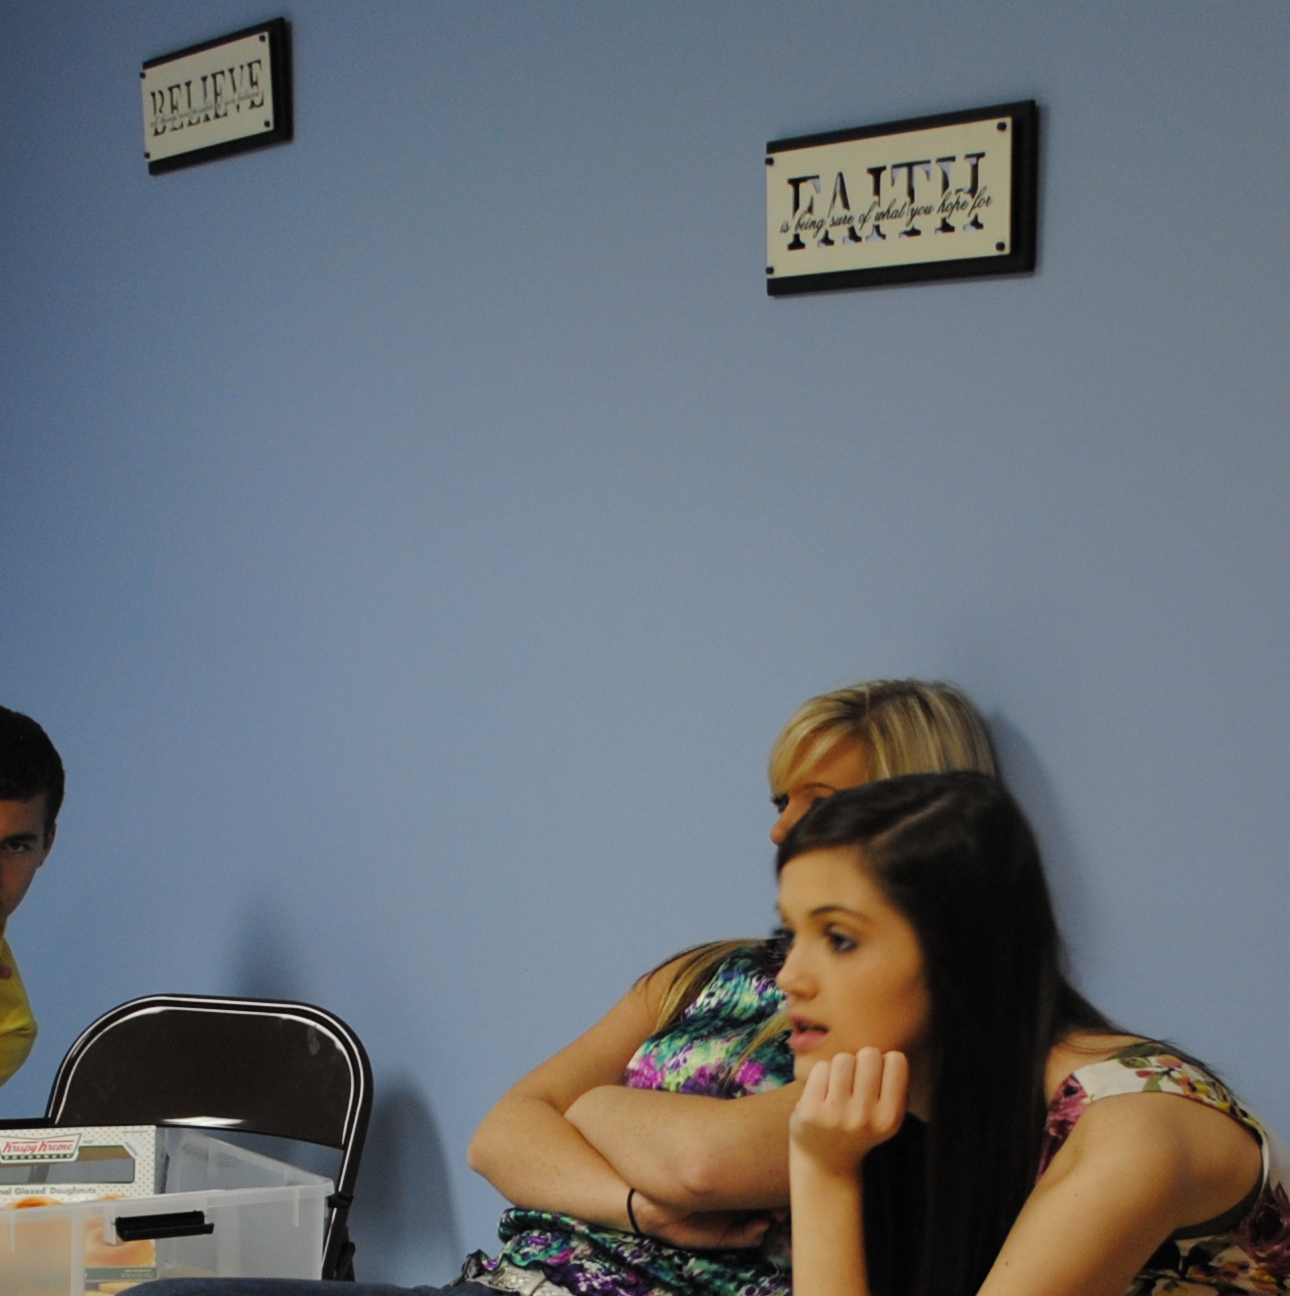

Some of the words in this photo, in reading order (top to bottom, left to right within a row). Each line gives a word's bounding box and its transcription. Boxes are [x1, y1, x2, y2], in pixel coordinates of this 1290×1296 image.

[150, 59, 265, 137] BELIEVE
[780, 220, 790, 234] is
[794, 209, 826, 239] being
[829, 214, 855, 228] sure
[858, 200, 877, 232] of
[874, 198, 907, 222] what
[905, 205, 934, 228] you
[936, 190, 969, 218] hope
[967, 185, 993, 218] for
[786, 152, 986, 251] FAITH
[50, 1185, 96, 1196] Doughnuts
